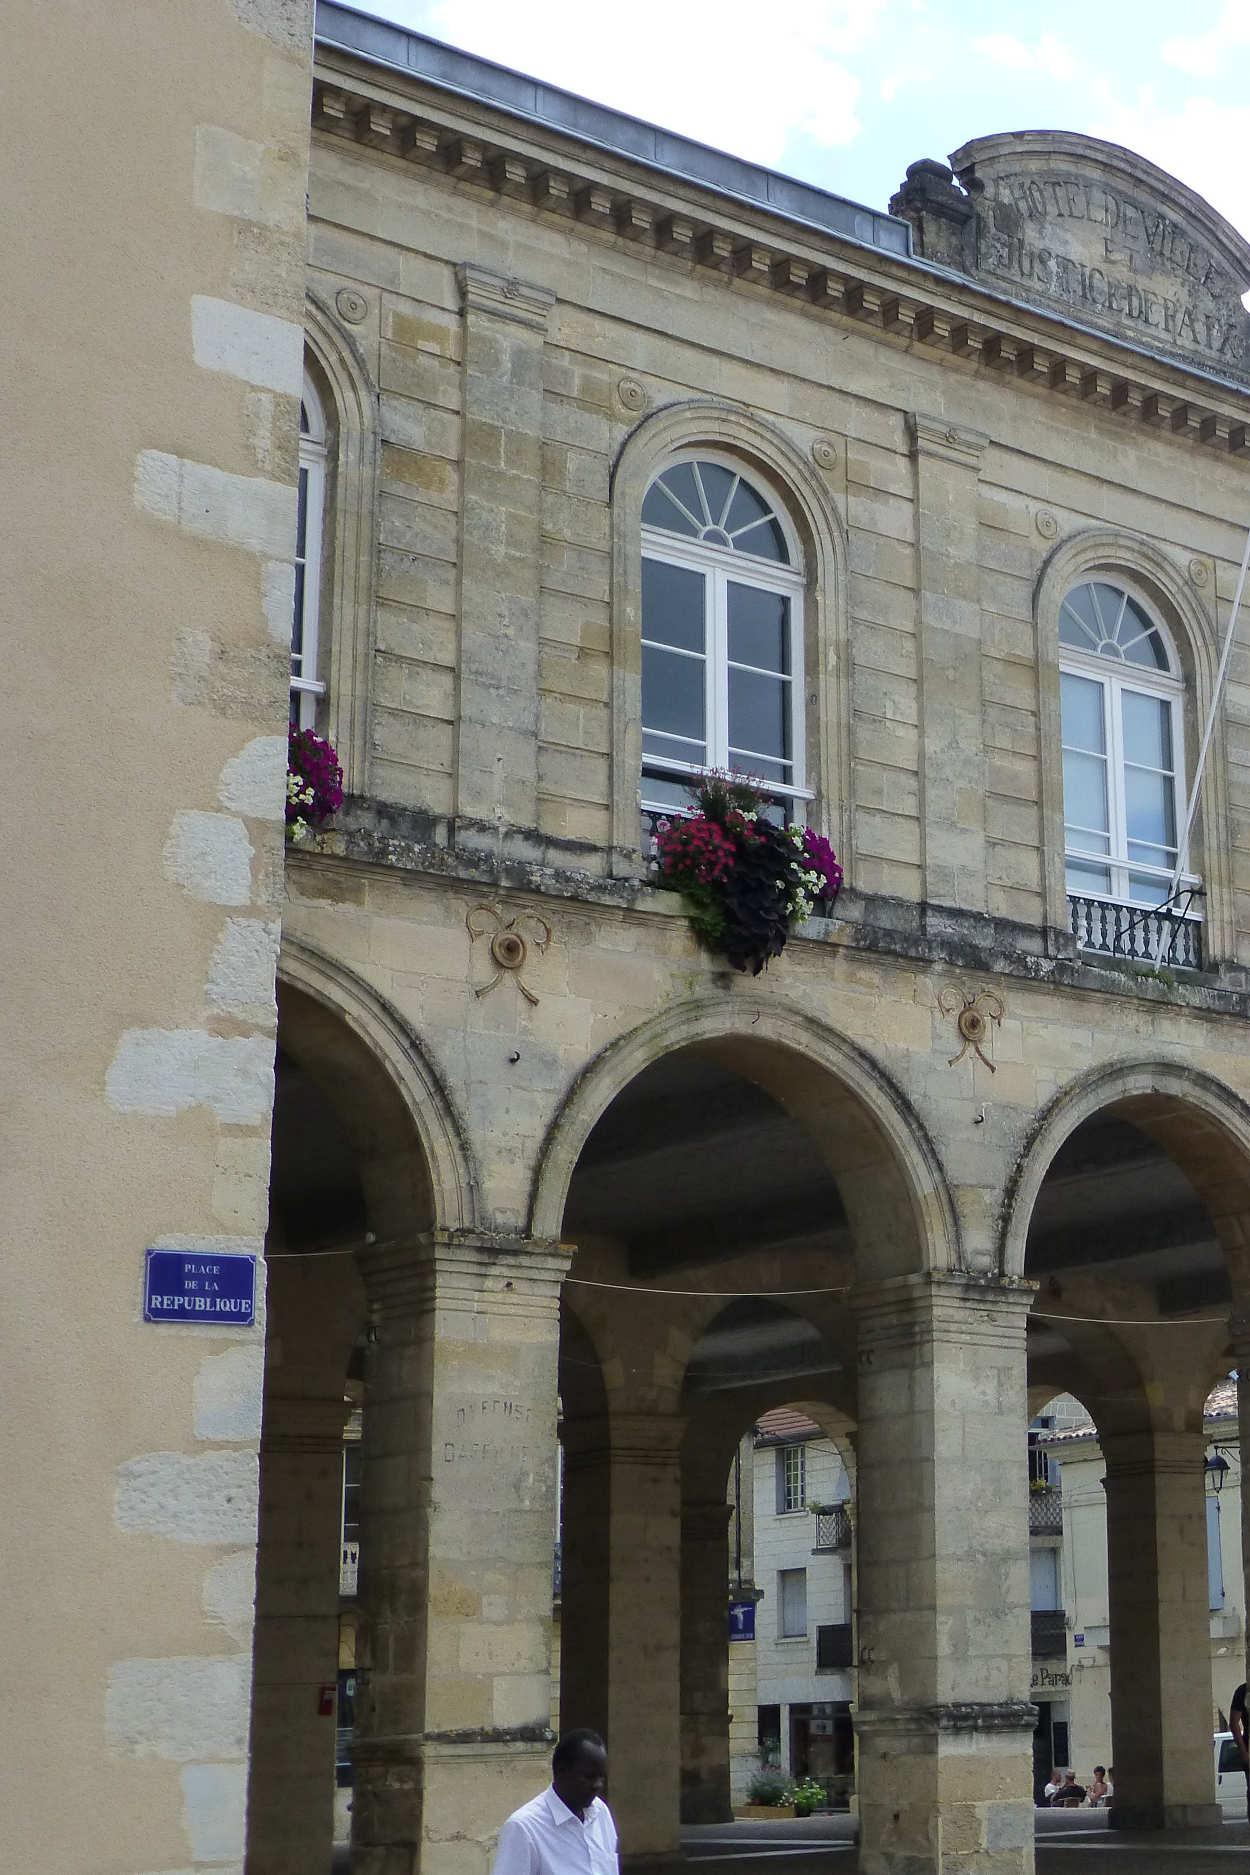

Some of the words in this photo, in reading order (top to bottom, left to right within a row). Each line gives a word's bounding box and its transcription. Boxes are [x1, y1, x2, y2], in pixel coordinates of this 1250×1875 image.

[184, 1264, 220, 1275] PLACE
[184, 1280, 198, 1290] DE
[204, 1281, 219, 1291] LA
[151, 1295, 251, 1313] REPUBLIQUE
